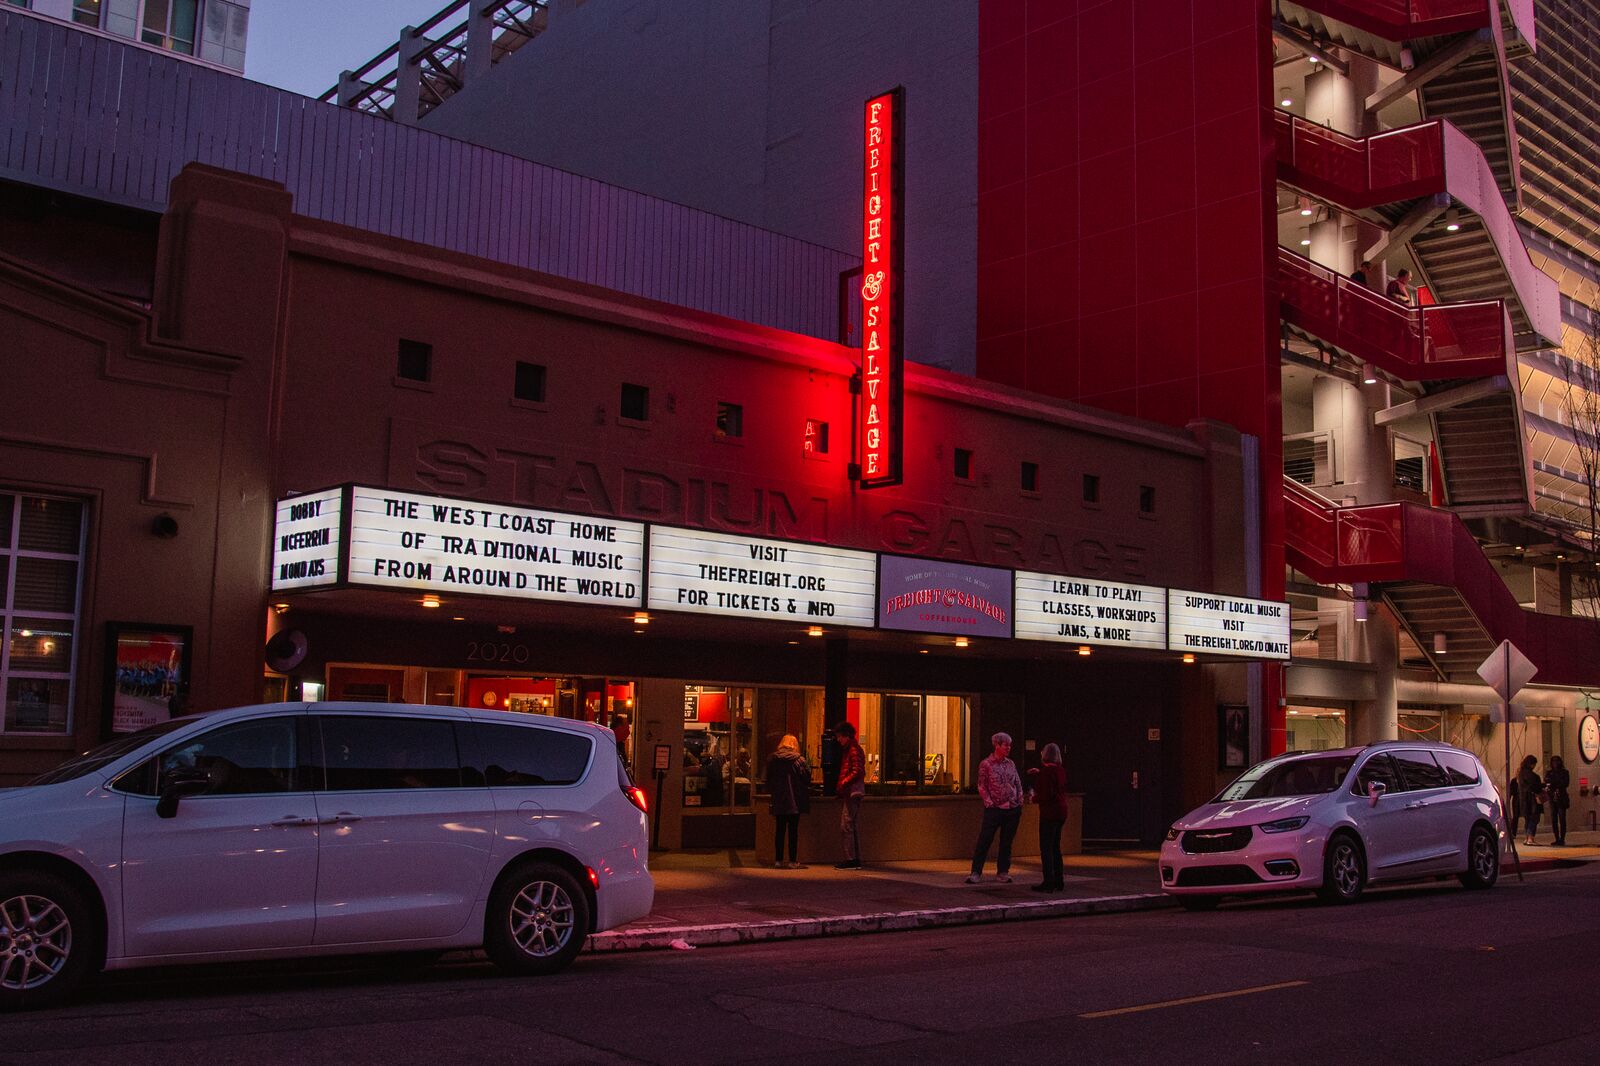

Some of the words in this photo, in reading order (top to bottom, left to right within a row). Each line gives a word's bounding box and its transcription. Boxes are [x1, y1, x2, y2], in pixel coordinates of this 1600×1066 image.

[868, 102, 883, 263] FREIGHT
[862, 270, 885, 301] &
[867, 305, 881, 474] SALVAGE
[290, 500, 322, 521] BOBBY
[384, 498, 419, 519] THE
[499, 513, 556, 536] COAST
[570, 522, 617, 543] HOME
[416, 440, 829, 544] STADIUM
[880, 509, 1147, 578] GARAGE
[281, 527, 330, 552] MCFERRIN
[401, 531, 426, 550] OF
[572, 550, 623, 571] MUSIC
[749, 544, 788, 563] VISIT
[280, 558, 325, 580] MONDAYS
[374, 558, 432, 580] FROM
[443, 565, 527, 590] AROUND
[535, 574, 567, 594] THE
[577, 578, 636, 600] WORLD
[699, 564, 826, 592] THEFREIGHT.ORG
[677, 588, 708, 606] FOR
[717, 592, 780, 612] TICKETS
[787, 599, 797, 613] &
[1053, 580, 1089, 596] LEARN
[1095, 585, 1108, 598] TO
[1112, 587, 1142, 602] PLAY!
[886, 588, 941, 615] FREIGHT
[942, 588, 957, 608] &
[957, 591, 1006, 624] SALVAGE
[1042, 600, 1094, 619] CLASSES,
[1096, 606, 1157, 623] WORKSHOPS
[1185, 596, 1226, 612] SUPPORT
[1229, 601, 1255, 615] LOCAL
[1257, 604, 1281, 618] MUSIC
[1058, 623, 1090, 640] JAMS,
[1094, 626, 1101, 639] &
[1103, 627, 1131, 641] MORE
[1222, 619, 1245, 632] VISIT
[467, 641, 529, 664] 2020
